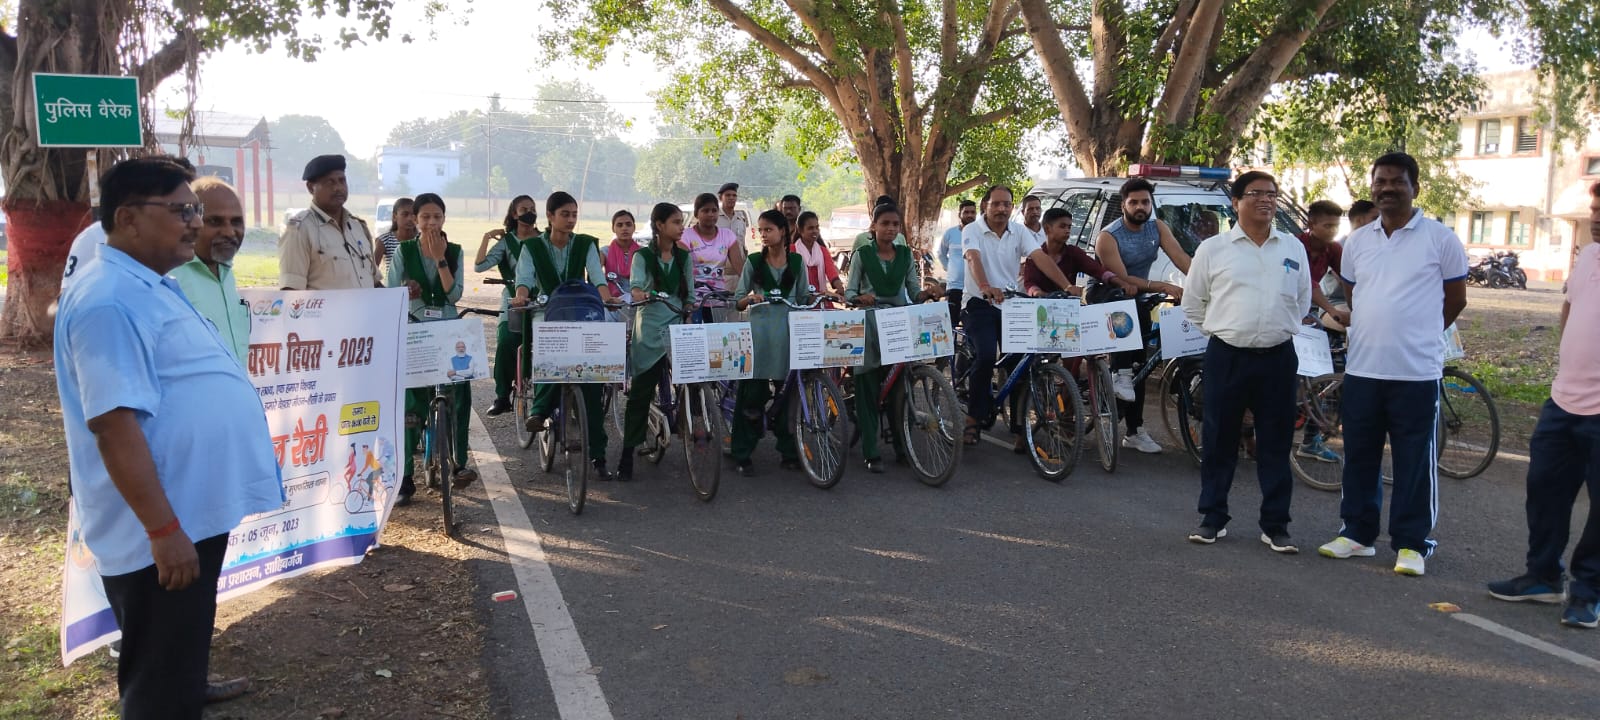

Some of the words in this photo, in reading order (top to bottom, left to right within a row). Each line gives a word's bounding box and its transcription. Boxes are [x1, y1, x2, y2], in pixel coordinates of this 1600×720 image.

[44, 97, 92, 123] पुलिस
[286, 332, 324, 373] दिवस
[338, 336, 373, 368] 2023
[291, 413, 329, 467] रैली
[247, 528, 258, 542] 05
[282, 518, 300, 533] 2023
